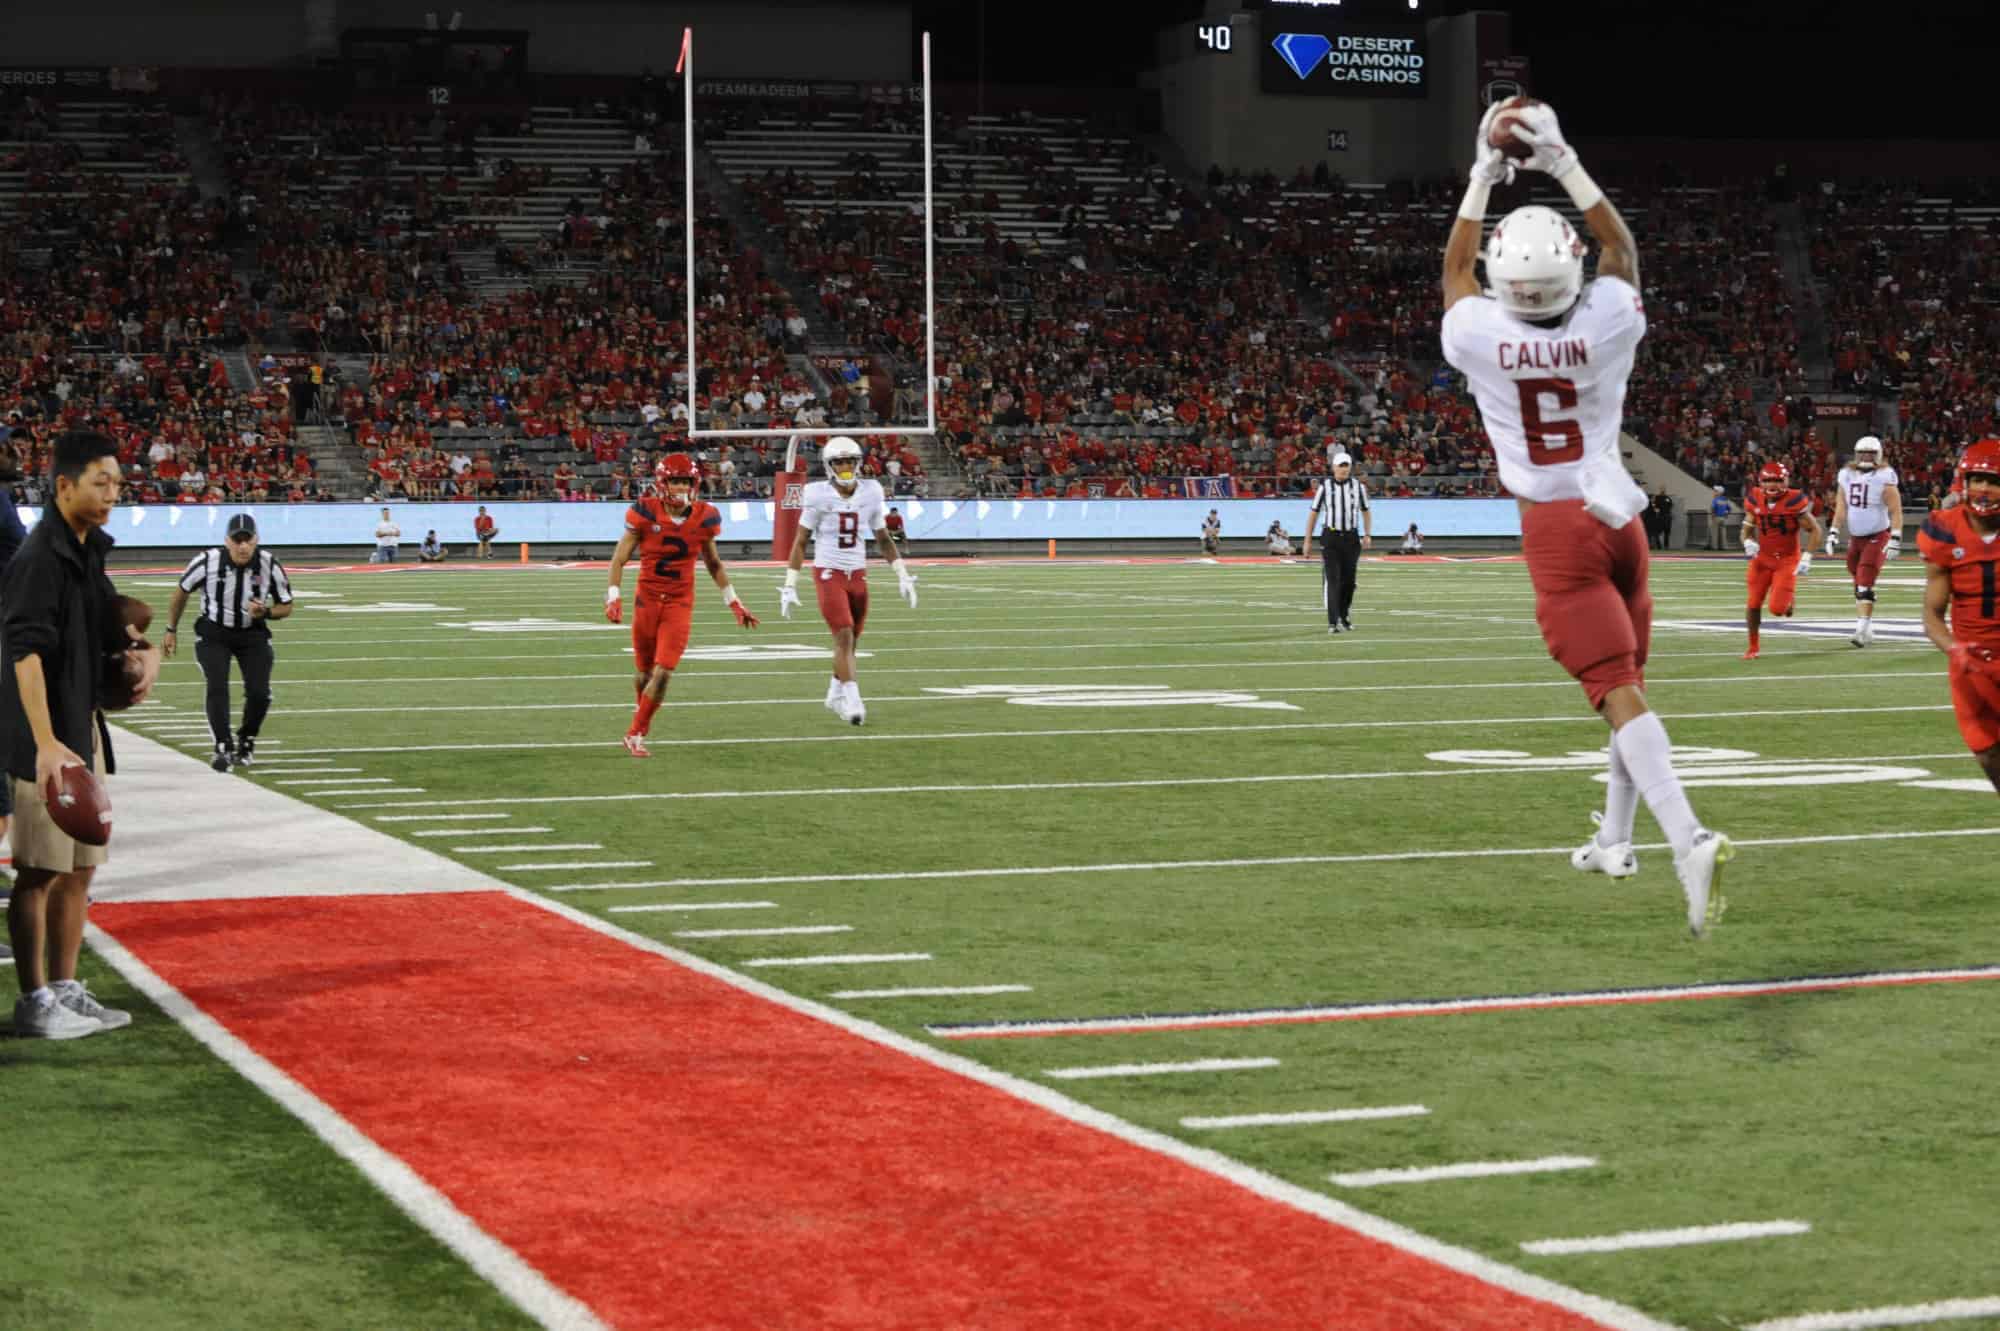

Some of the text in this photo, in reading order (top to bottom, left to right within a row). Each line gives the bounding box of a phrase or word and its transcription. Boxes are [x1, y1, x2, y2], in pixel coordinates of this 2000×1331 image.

[1199, 26, 1230, 50] 40
[1337, 36, 1415, 52] DESERT
[1329, 52, 1423, 68] DIAMOND
[0, 72, 56, 85] EROES
[1331, 67, 1421, 84] CASINOS
[429, 87, 449, 104] 12
[1328, 132, 1347, 149] 14
[1498, 338, 1588, 370] CALVIN
[1512, 378, 1585, 466] 6
[1850, 483, 1869, 509] 61
[838, 511, 859, 549] 9
[1760, 514, 1788, 536] 14
[655, 536, 689, 579] 2
